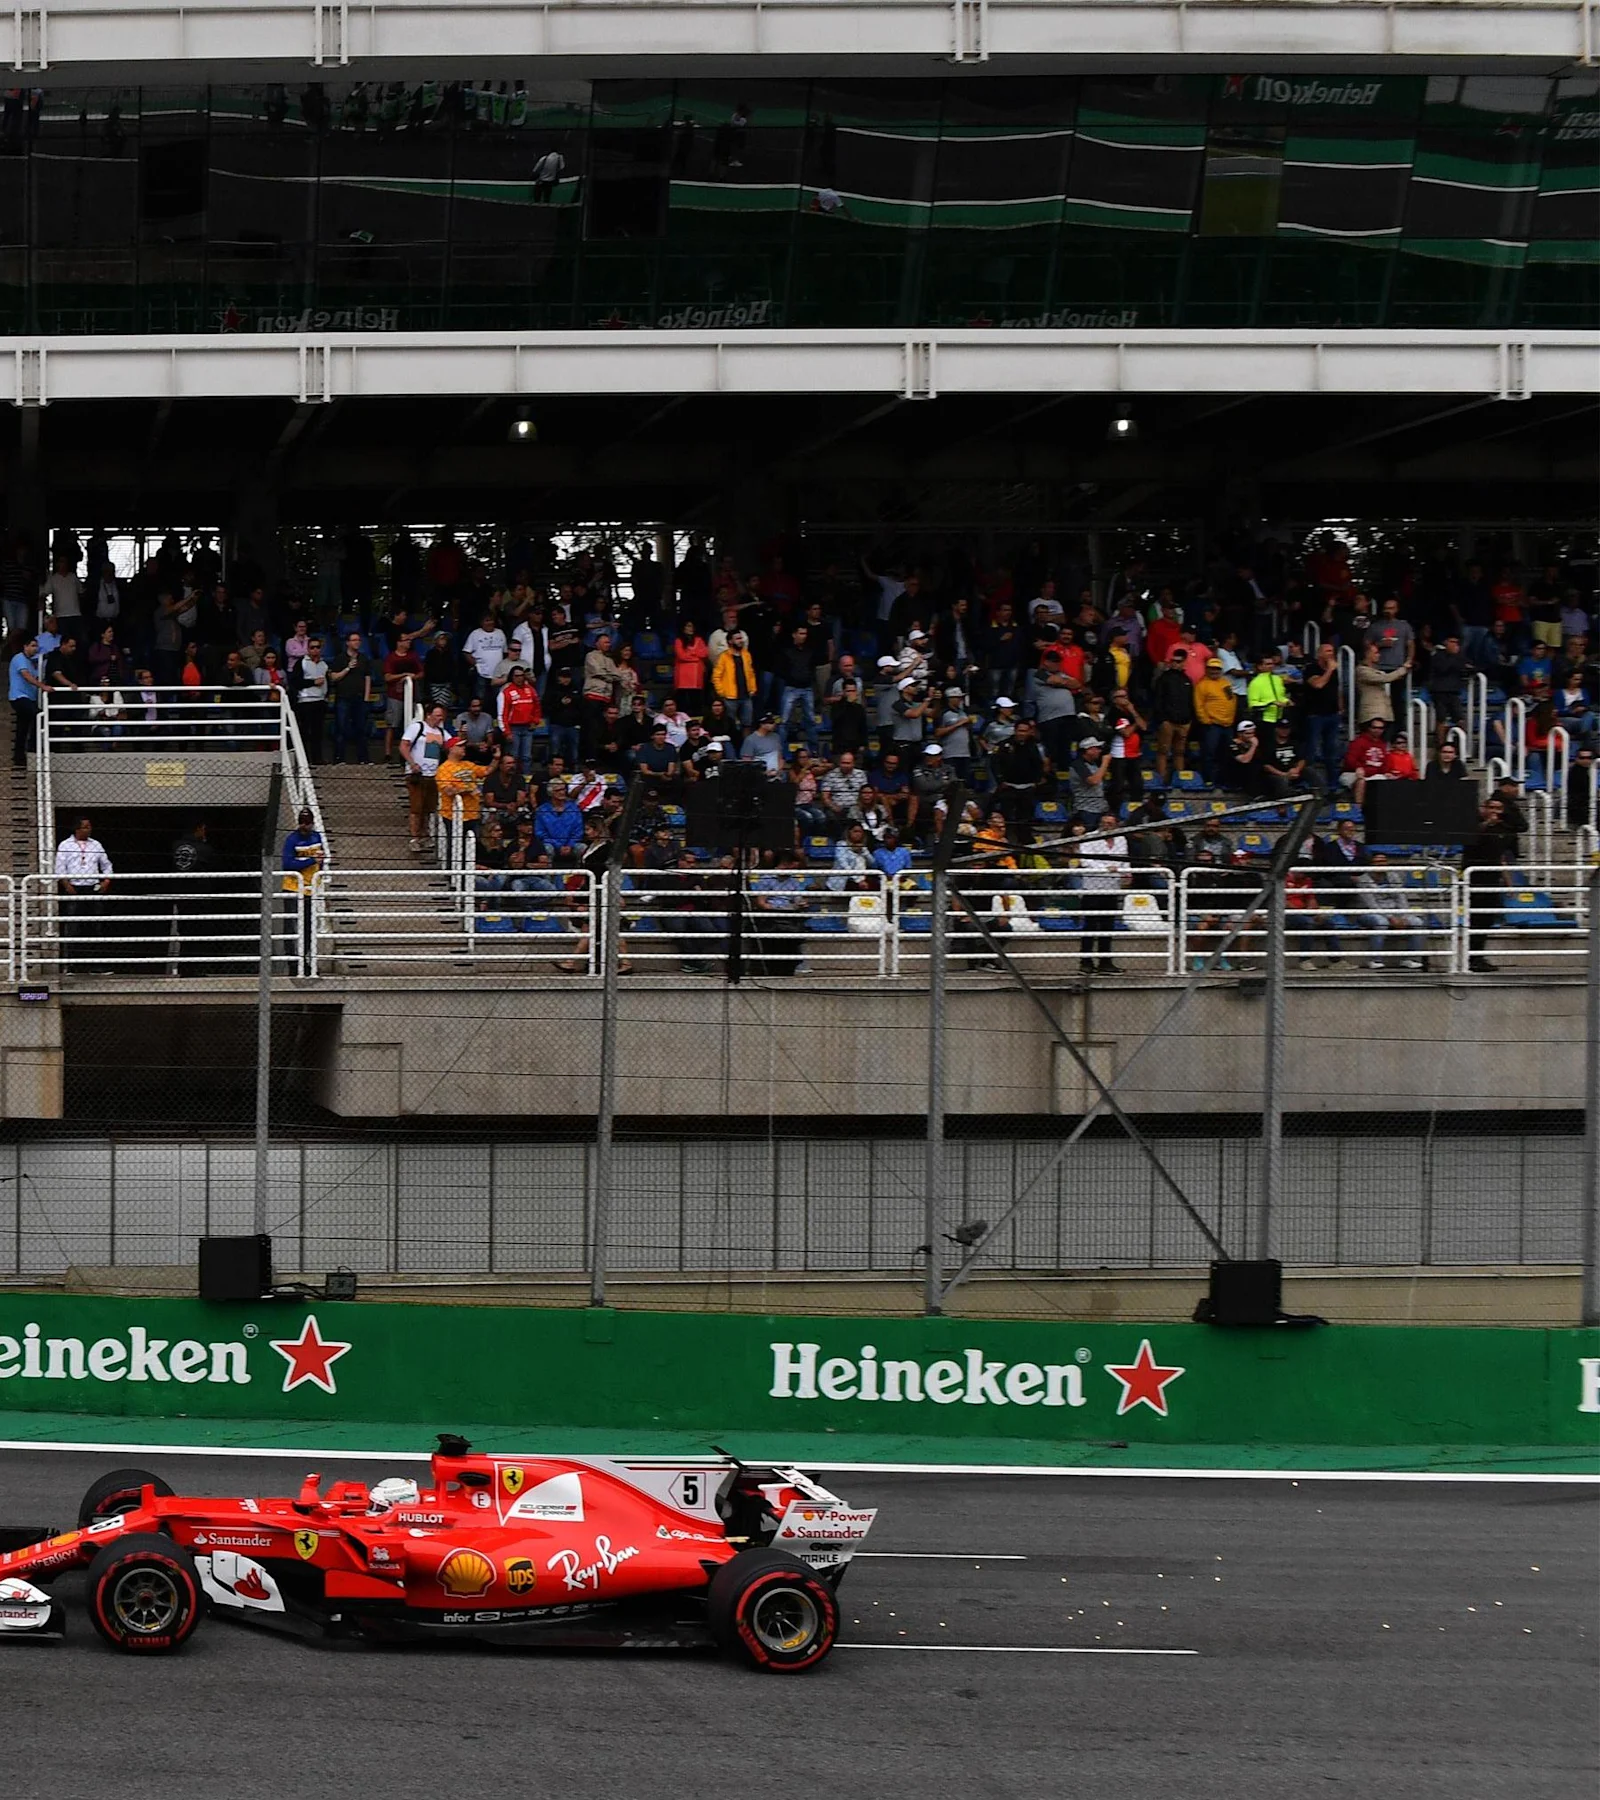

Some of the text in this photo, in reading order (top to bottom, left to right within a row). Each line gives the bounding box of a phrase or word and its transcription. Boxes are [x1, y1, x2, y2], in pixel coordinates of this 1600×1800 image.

[769, 1343, 1087, 1407] Heineken
[683, 1475, 698, 1505] 5
[477, 1492, 485, 1507] E
[398, 1513, 444, 1524] HUBLOT
[816, 1511, 873, 1522] V-Power
[208, 1532, 272, 1547] Santander
[798, 1526, 864, 1539] Santander
[547, 1535, 640, 1591] Ray-Ban
[801, 1554, 838, 1563] MAHLE
[507, 1568, 535, 1591] ups
[443, 1612, 471, 1623] infor
